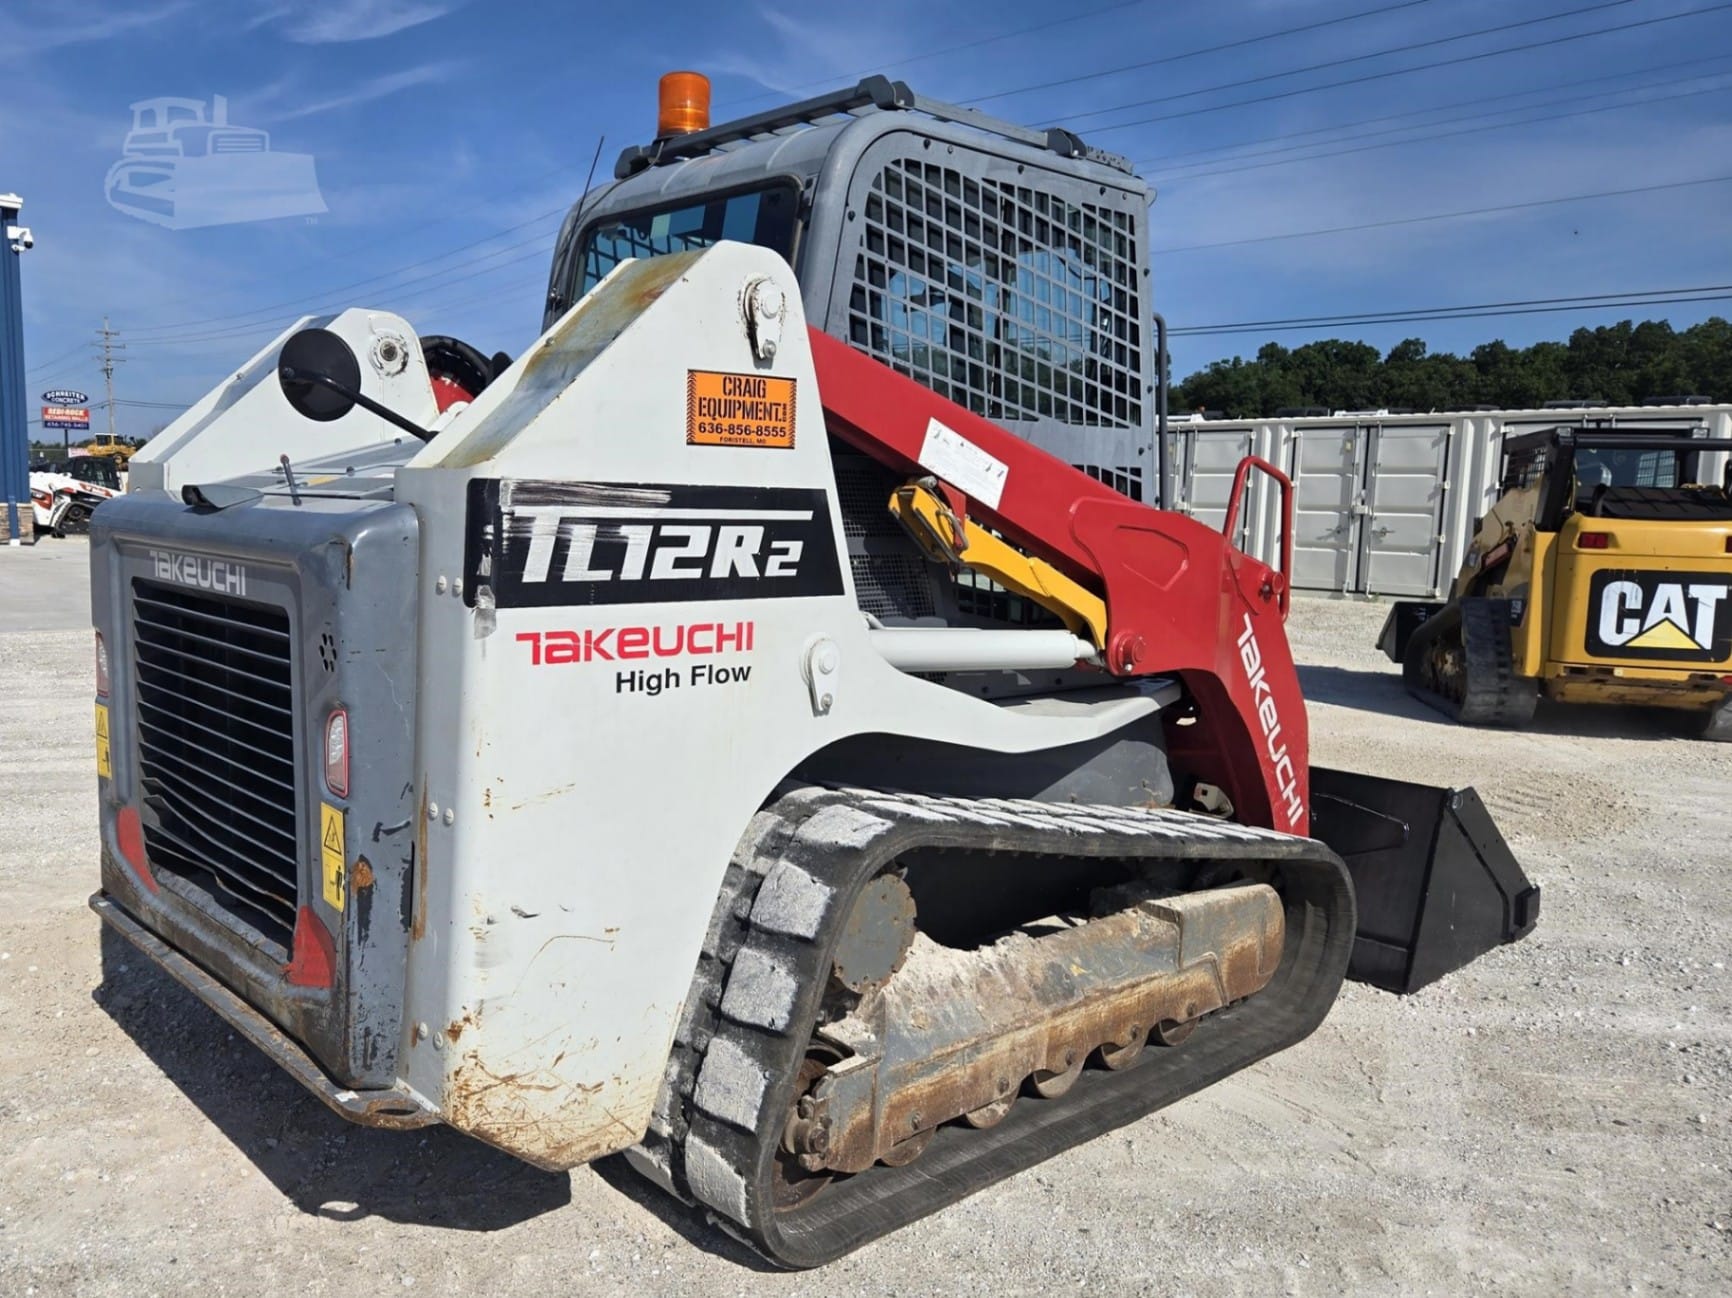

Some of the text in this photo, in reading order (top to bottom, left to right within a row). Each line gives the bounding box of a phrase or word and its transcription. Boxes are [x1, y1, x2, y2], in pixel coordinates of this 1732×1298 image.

[722, 376, 767, 398] CRAIG
[698, 422, 787, 437] 636-856-8555
[514, 506, 814, 584] TL12R2
[149, 550, 247, 597] TAKEUCHI
[1598, 580, 1728, 650] CAT
[515, 621, 755, 666] TAKEUCHI
[615, 664, 753, 696] High Flow
[1237, 611, 1304, 828] TAKEUCHI
